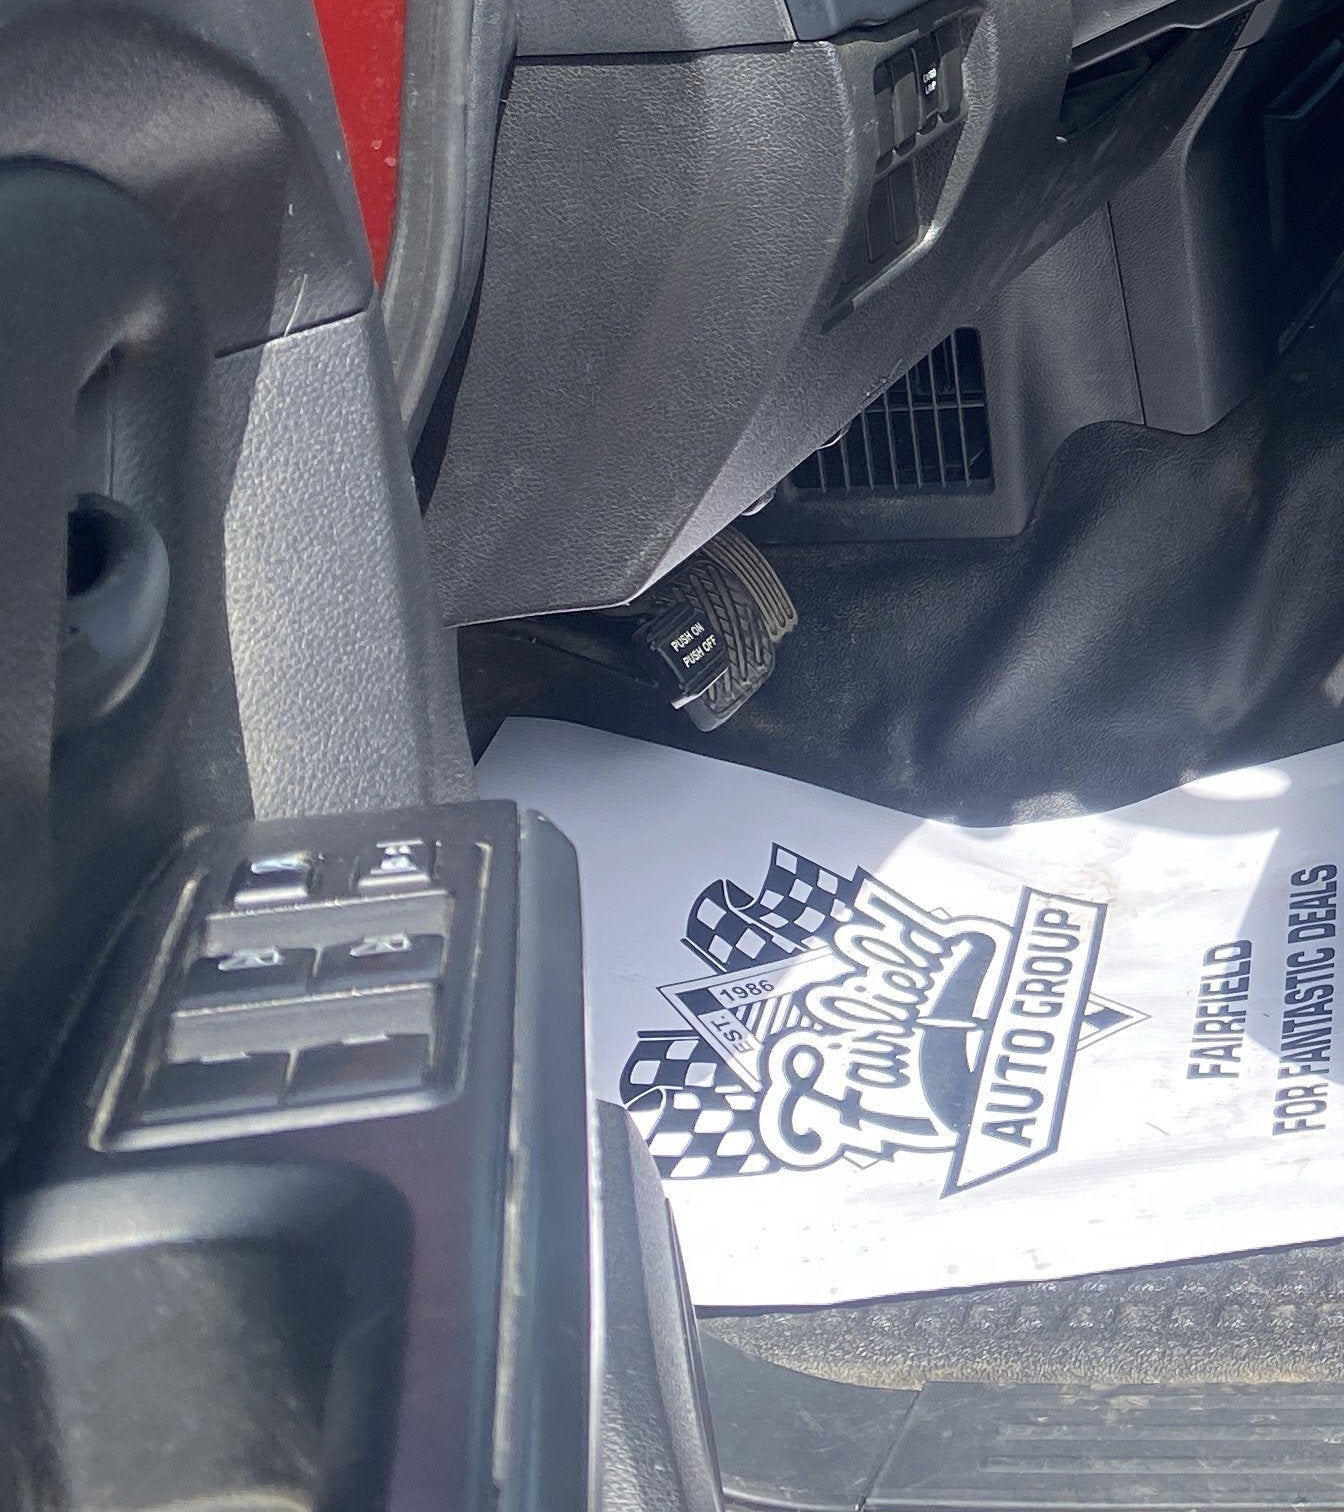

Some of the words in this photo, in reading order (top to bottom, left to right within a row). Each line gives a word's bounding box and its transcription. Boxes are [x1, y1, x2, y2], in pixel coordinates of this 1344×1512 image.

[671, 631, 694, 652] PUSH
[690, 622, 705, 636] ON
[682, 646, 705, 668] PUSH
[702, 634, 717, 652] OFF
[1288, 864, 1338, 944] DEALS
[719, 979, 776, 1002] 1986
[1010, 907, 1081, 1019] GROUP
[710, 1015, 755, 1053] EST.
[778, 892, 954, 1155] Fairfield
[1187, 940, 1252, 1079] FAIRFIELD
[1278, 947, 1336, 1079] FANTASTIC
[981, 1028, 1056, 1148] AUTO
[1272, 1083, 1329, 1136] FOR
